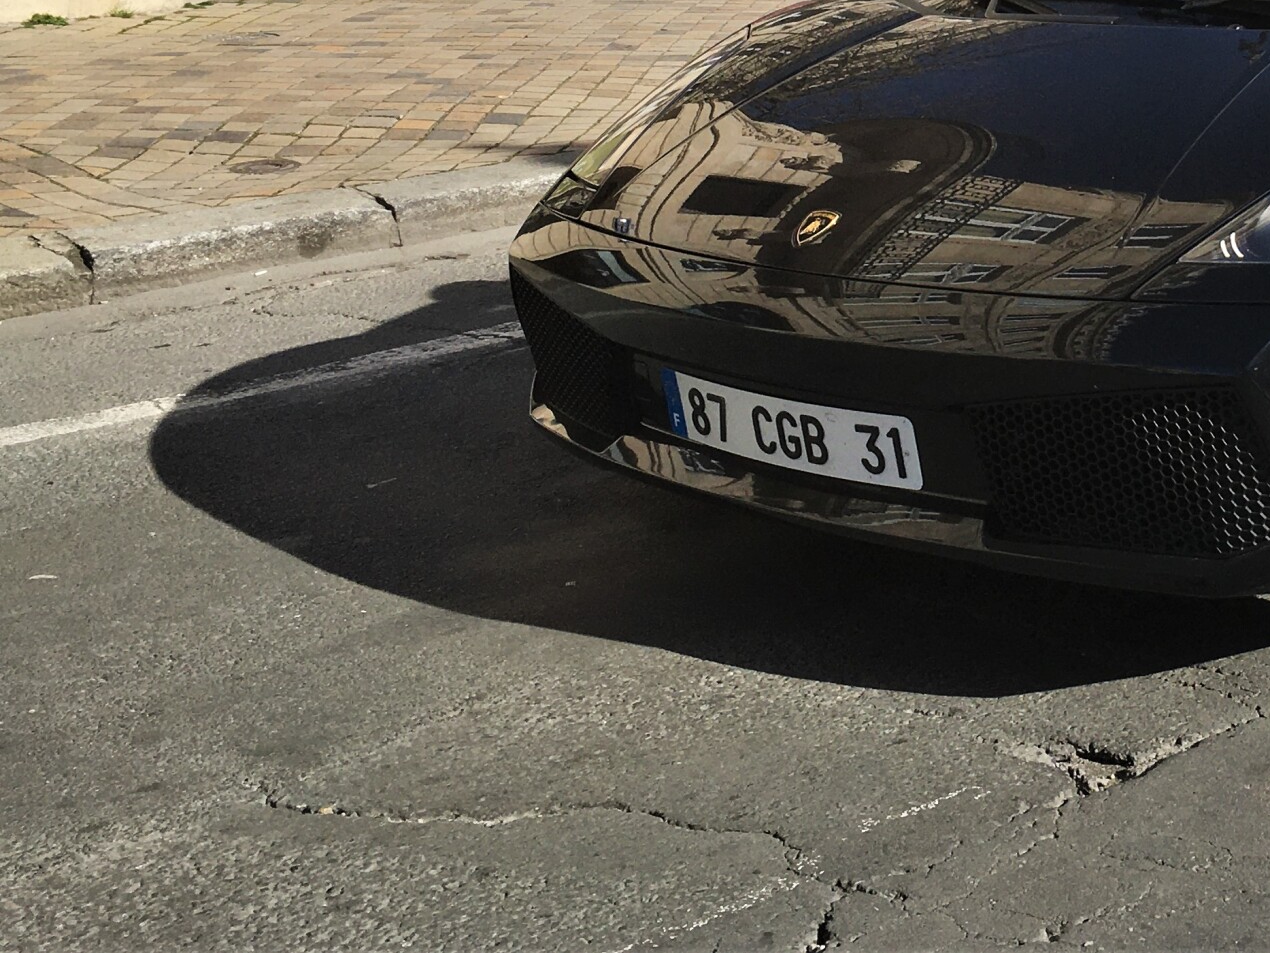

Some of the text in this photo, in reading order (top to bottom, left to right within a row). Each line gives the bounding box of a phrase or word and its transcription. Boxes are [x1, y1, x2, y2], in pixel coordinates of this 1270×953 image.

[673, 387, 907, 479] F 87 CGB 31
